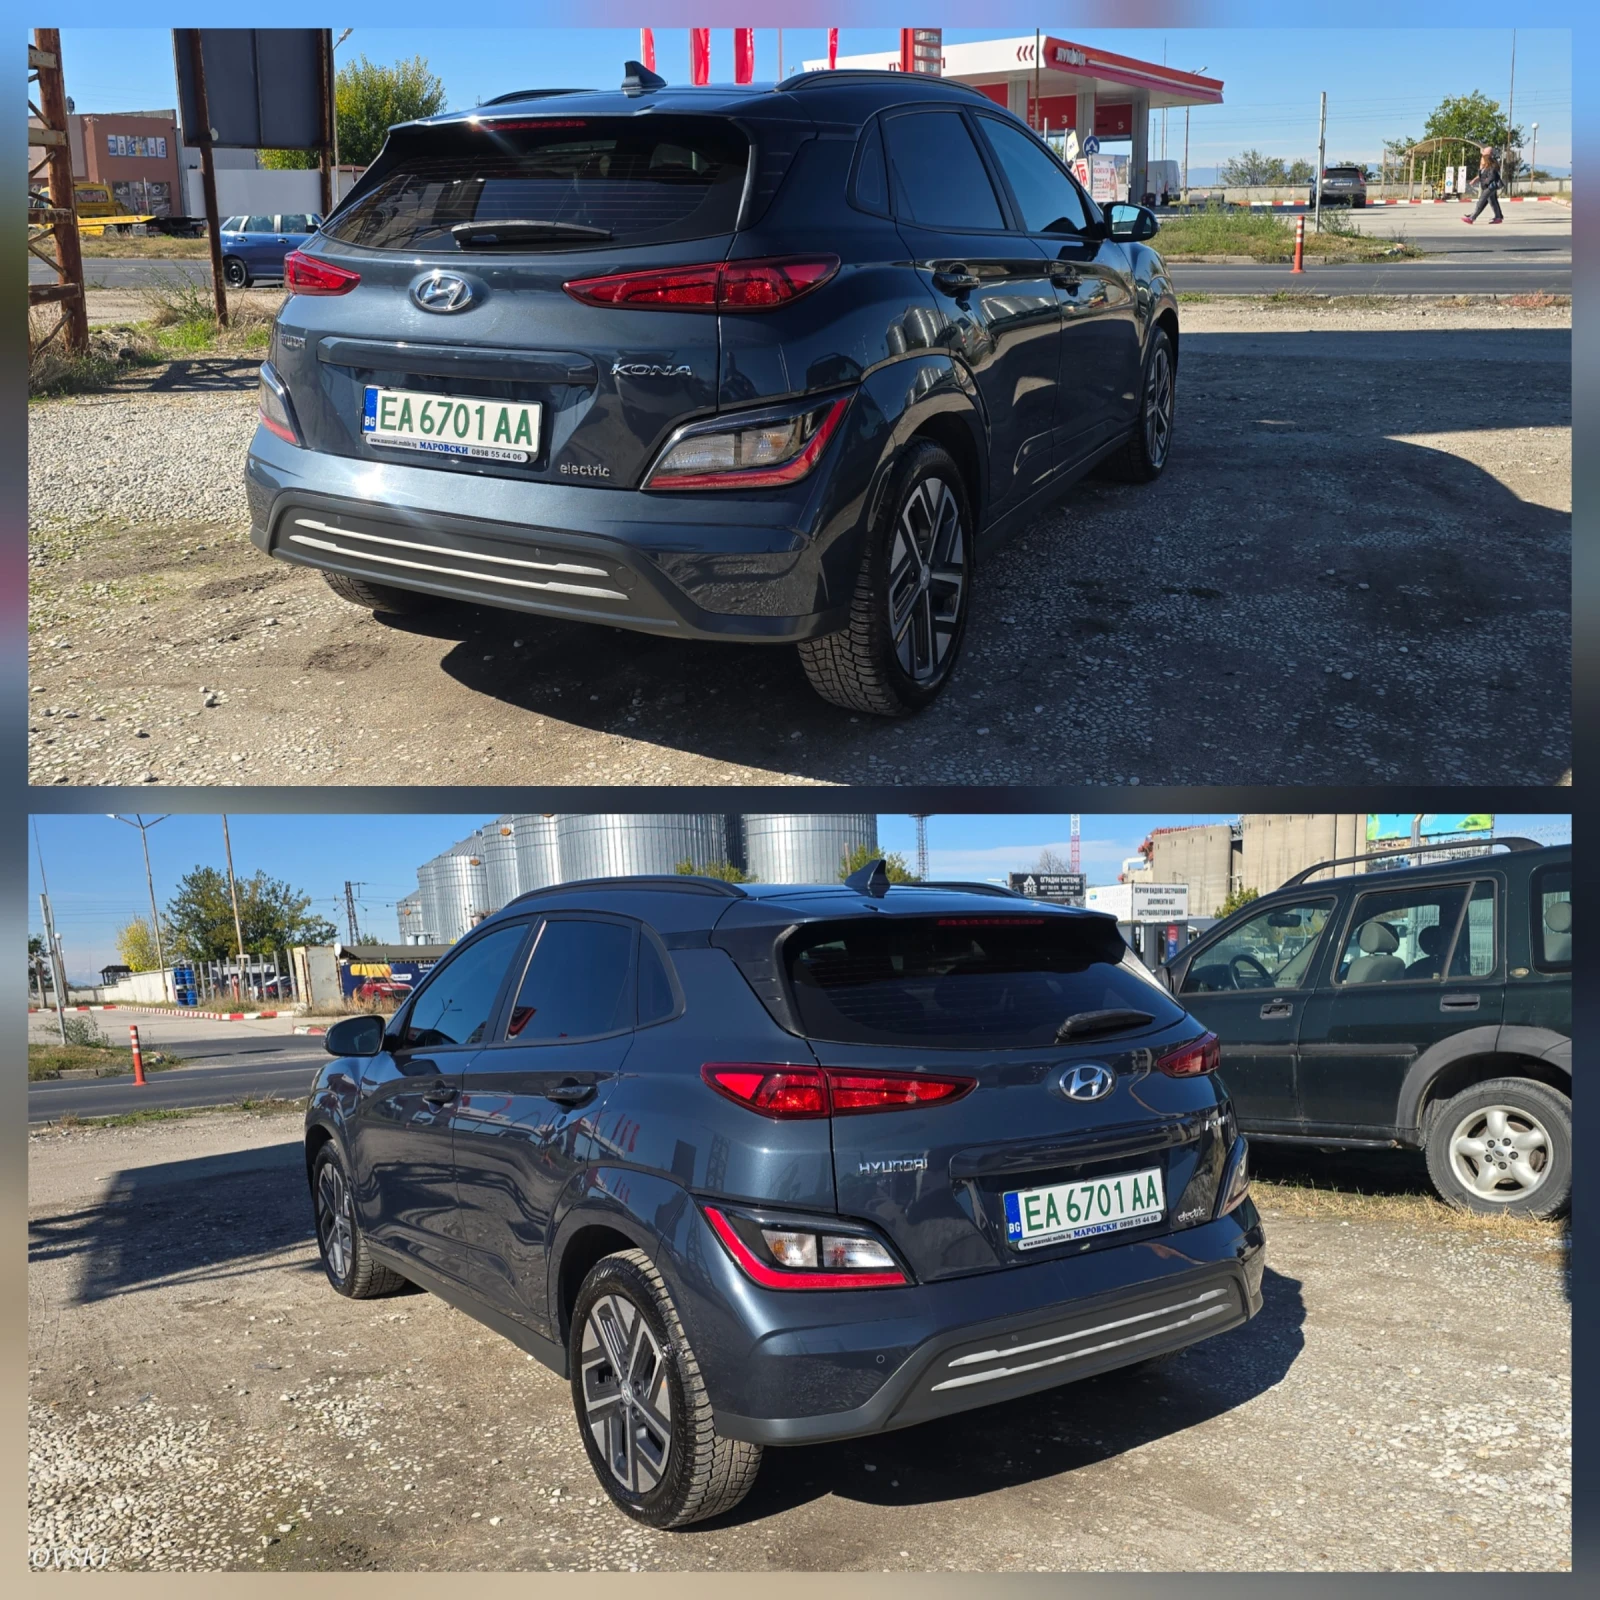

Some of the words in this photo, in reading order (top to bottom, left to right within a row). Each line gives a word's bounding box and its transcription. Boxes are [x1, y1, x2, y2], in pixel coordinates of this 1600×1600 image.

[1061, 115, 1068, 124] 3
[1118, 121, 1124, 130] 5
[609, 363, 692, 376] KONA
[364, 415, 376, 427] BG
[379, 395, 414, 433] EA
[419, 400, 485, 441] 6701
[493, 407, 533, 446] AA
[419, 441, 469, 455] МАРОВСКИ
[471, 448, 489, 457] 0898
[491, 450, 500, 458] 55
[501, 452, 511, 460] 44
[512, 453, 522, 461] 06
[560, 462, 610, 477] electric
[858, 1158, 928, 1174] HYUNDAI
[1024, 1192, 1061, 1232] EA
[1066, 1180, 1125, 1223] 6701
[1131, 1175, 1160, 1212] AA
[1009, 1223, 1021, 1234] BG
[1073, 1222, 1118, 1238] МАРОВСКИ
[1135, 1217, 1142, 1226] 55
